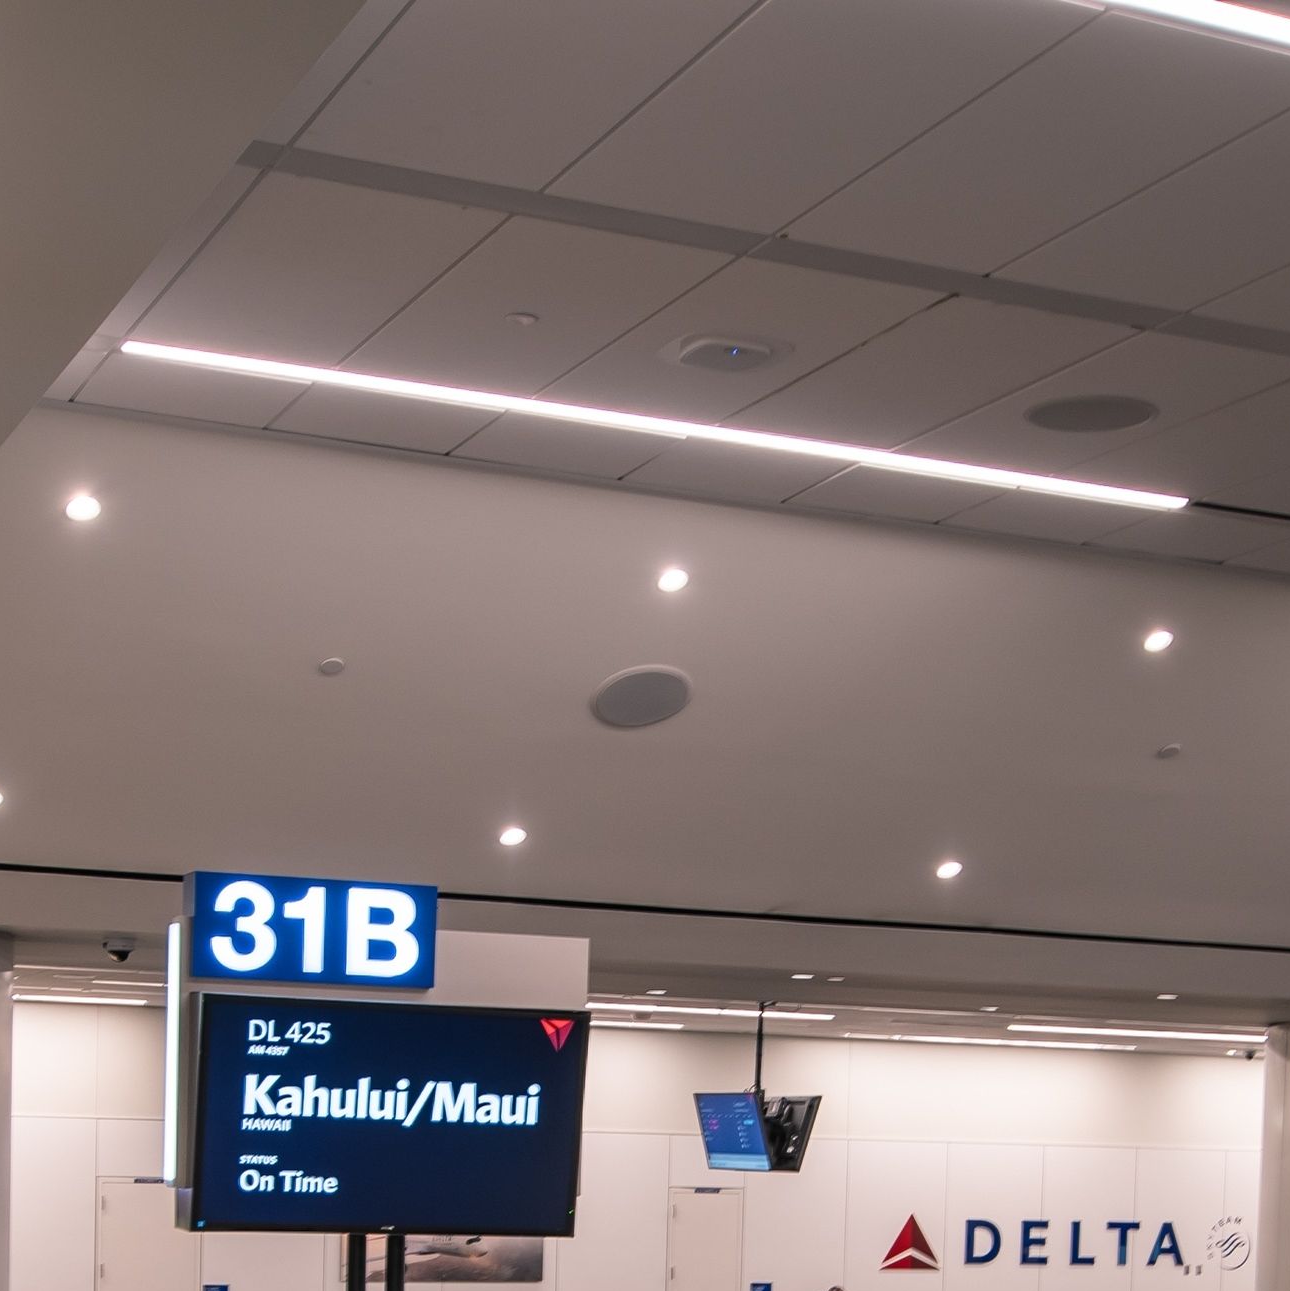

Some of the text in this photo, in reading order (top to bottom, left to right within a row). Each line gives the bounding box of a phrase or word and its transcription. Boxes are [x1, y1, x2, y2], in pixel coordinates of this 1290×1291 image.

[211, 880, 420, 978] 31B
[248, 1019, 332, 1045] DL 425
[243, 1073, 541, 1127] Kahului/Maui
[241, 1118, 292, 1132] HAWAII
[239, 1154, 278, 1165] STATUS
[239, 1169, 339, 1194] On Time
[964, 1219, 1184, 1267] DELTA
